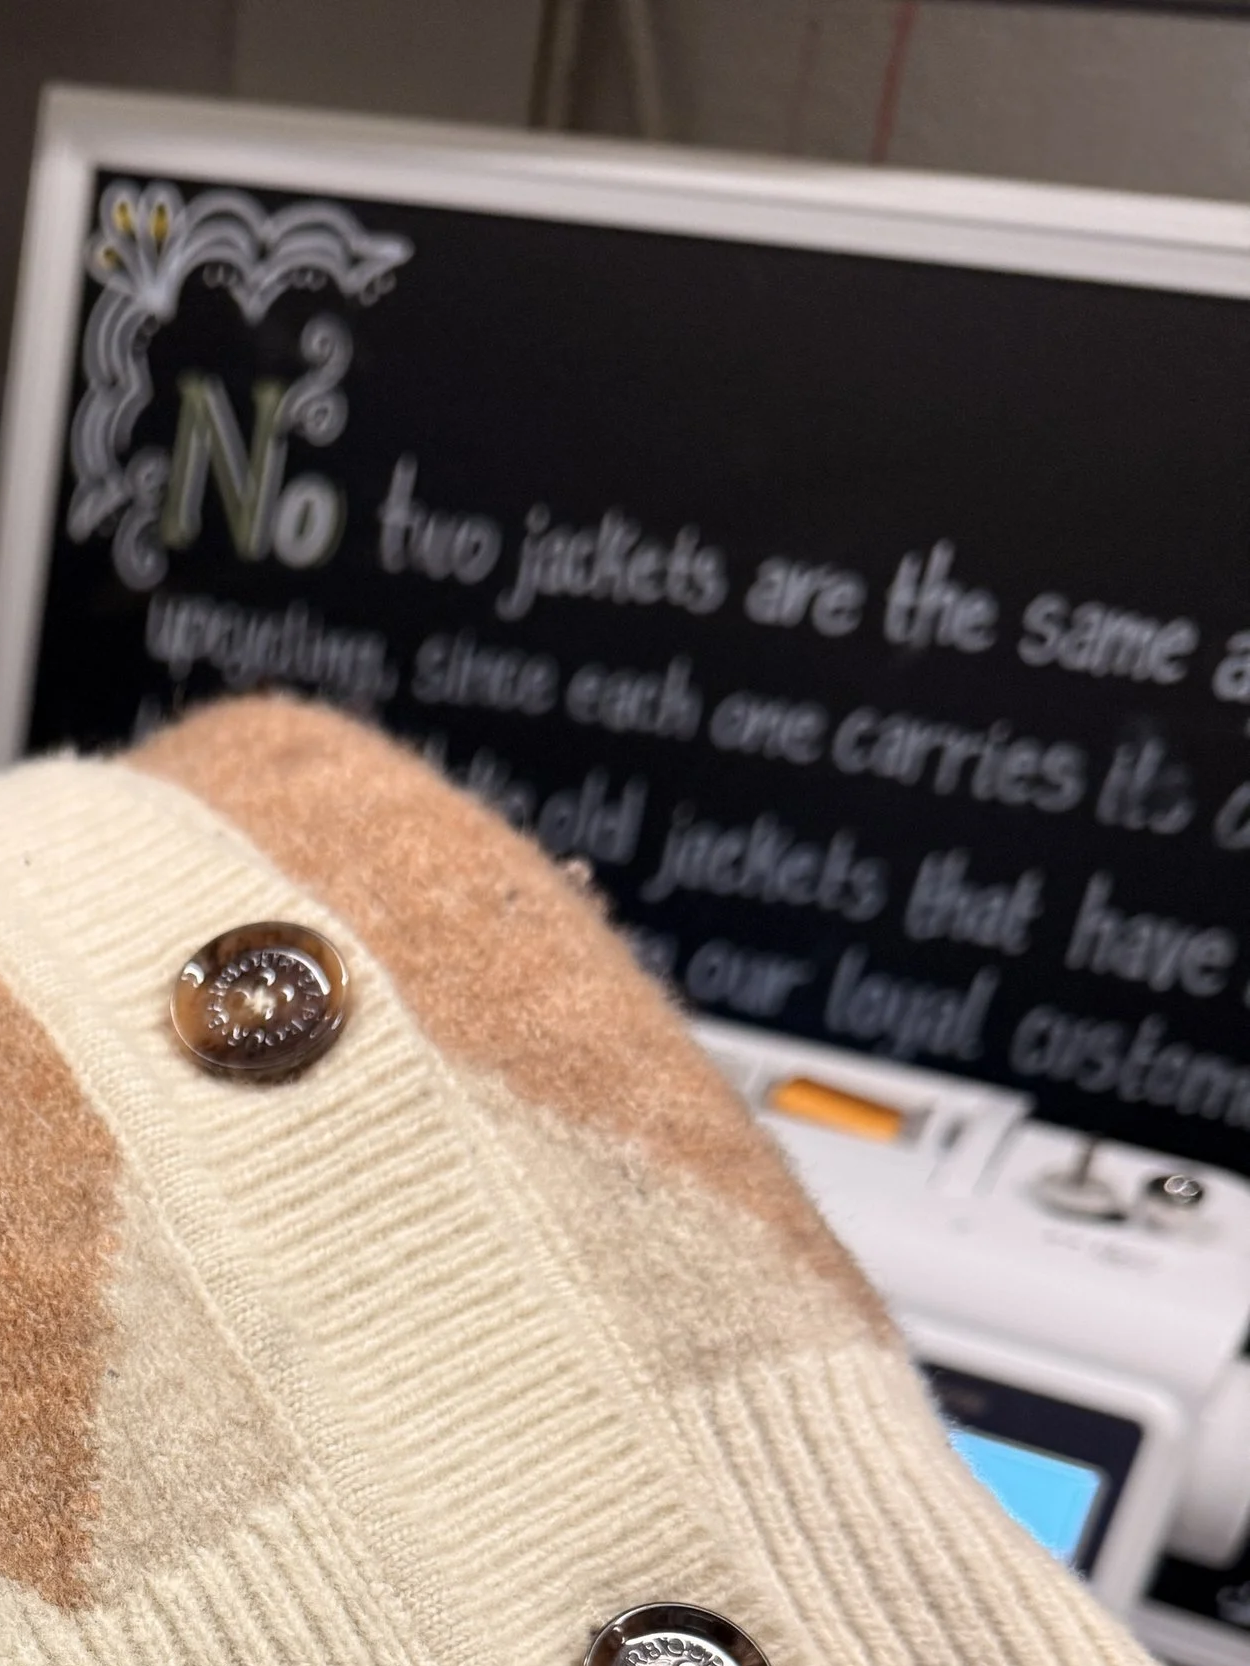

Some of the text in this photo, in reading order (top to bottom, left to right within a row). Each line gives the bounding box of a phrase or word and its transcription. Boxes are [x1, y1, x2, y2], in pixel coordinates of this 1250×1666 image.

[158, 372, 349, 570] No
[378, 452, 502, 584] two
[495, 500, 728, 622] jackets
[745, 553, 868, 638] are
[882, 535, 1000, 655] the
[1017, 590, 1201, 686] same
[412, 630, 558, 716] since
[565, 652, 704, 742] each
[708, 688, 828, 765] one
[831, 705, 1089, 814] carries
[641, 800, 890, 924] jackets
[903, 845, 1043, 955] that
[1065, 868, 1238, 998] have
[685, 935, 818, 1020] our
[824, 945, 1001, 1062] loyal
